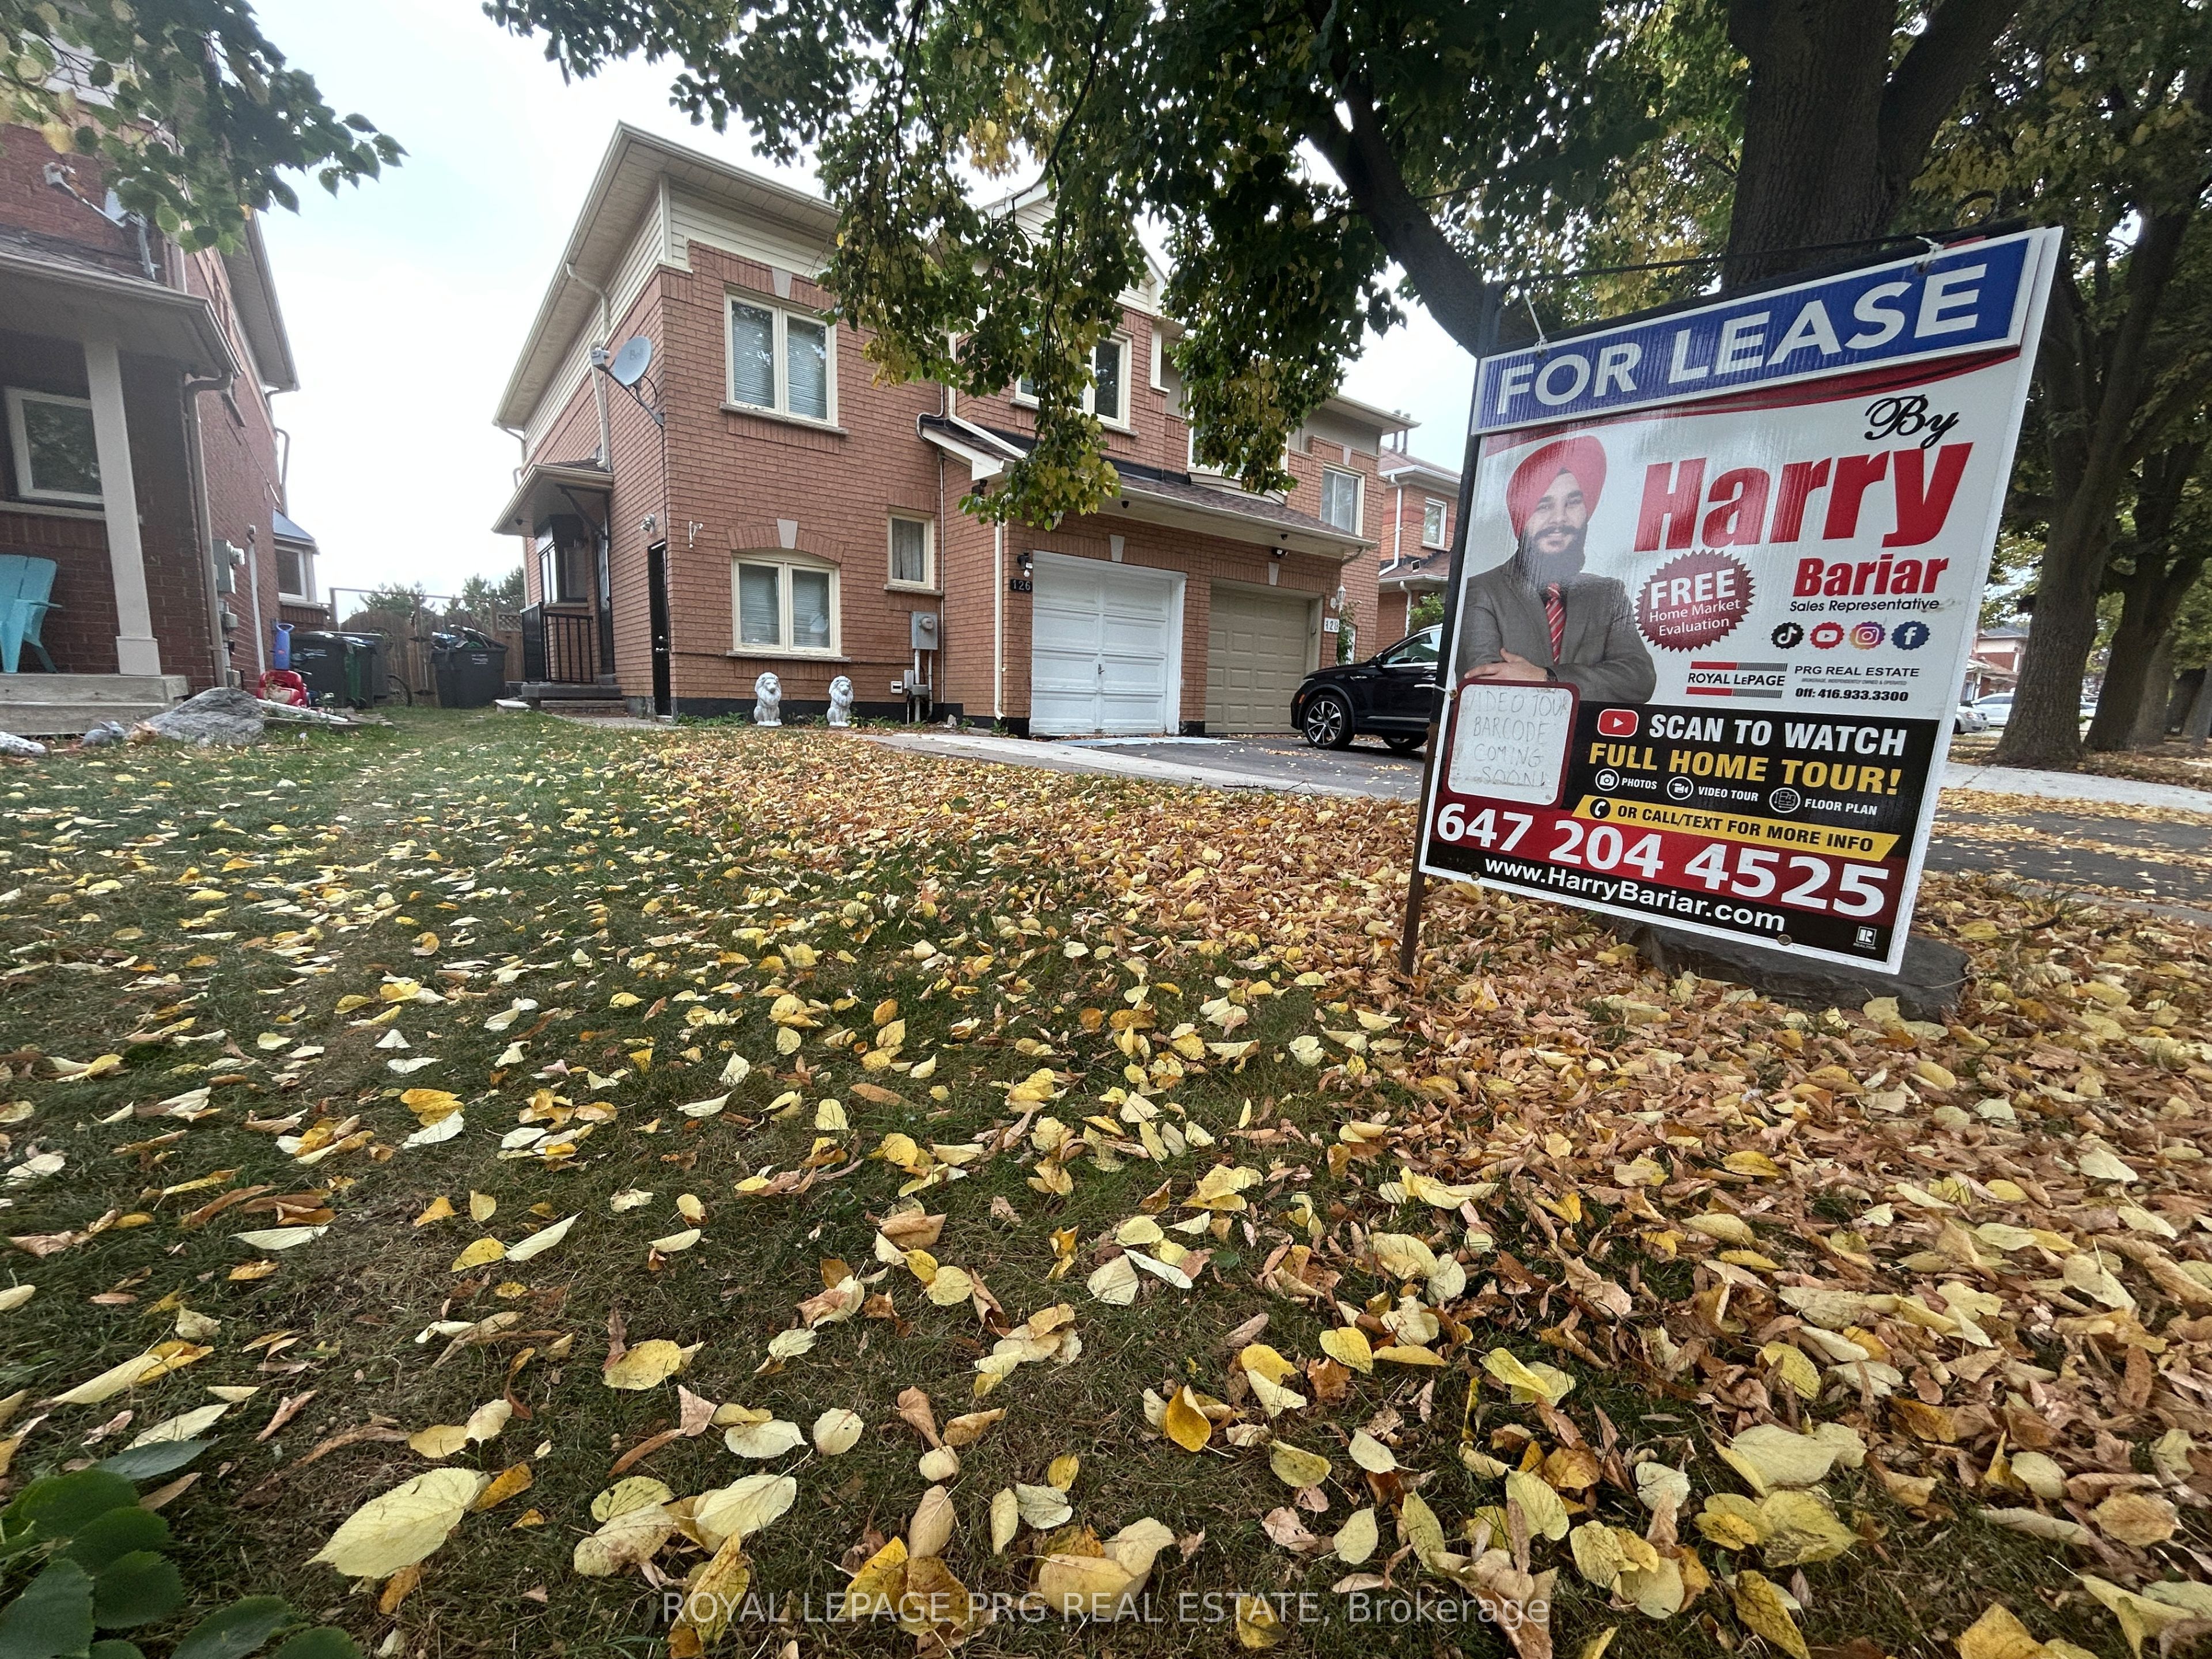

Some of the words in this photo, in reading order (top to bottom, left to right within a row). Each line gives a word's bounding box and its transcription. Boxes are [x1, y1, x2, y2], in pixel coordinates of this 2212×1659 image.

[1498, 344, 1642, 414] FOR
[1668, 263, 1987, 384] LEASE
[1864, 394, 1959, 449] By
[1633, 442, 1974, 552] Harry
[1013, 579, 1031, 590] 126
[1793, 554, 1949, 596] Bariar
[1651, 569, 1735, 609] FREE
[1650, 609, 1687, 622] Home
[1692, 599, 1740, 616] Market
[1790, 601, 1824, 612] Sales
[1828, 598, 1940, 612] Representative
[1660, 618, 1729, 636] Evaluation
[1688, 673, 1730, 684] ROYAL
[1794, 666, 1822, 674] PRG
[1825, 666, 1862, 675] REAL
[1866, 667, 1920, 677] ESTATE
[1795, 688, 1815, 698] Off:
[1817, 689, 1908, 701] 416.933.3300
[1474, 716, 1550, 745] BARCODE
[1649, 714, 1725, 743] SCAN
[1734, 719, 1773, 746] TO
[1785, 722, 1907, 757] WATCH
[1474, 743, 1544, 767] COMING
[1589, 743, 1659, 771] FULL
[1668, 749, 1769, 781] HOME
[1781, 759, 1902, 795] TOUR!
[1621, 778, 1657, 790] PHOTOS
[1698, 786, 1728, 798] VIDEO
[1731, 790, 1759, 802] TOUR
[1804, 798, 1842, 812] FLOOR
[1845, 802, 1877, 816] PLAN
[1617, 805, 1637, 819] OR
[1642, 808, 1723, 831] CALL/TEXT
[1727, 821, 1761, 836] FOR
[1766, 827, 1820, 845] MORE
[1827, 833, 1873, 852] INFO
[1437, 803, 1533, 851] 647
[1549, 820, 1663, 878] 204
[1684, 843, 1890, 918] 4525
[1485, 858, 1785, 931] www.HarryBariar.com
